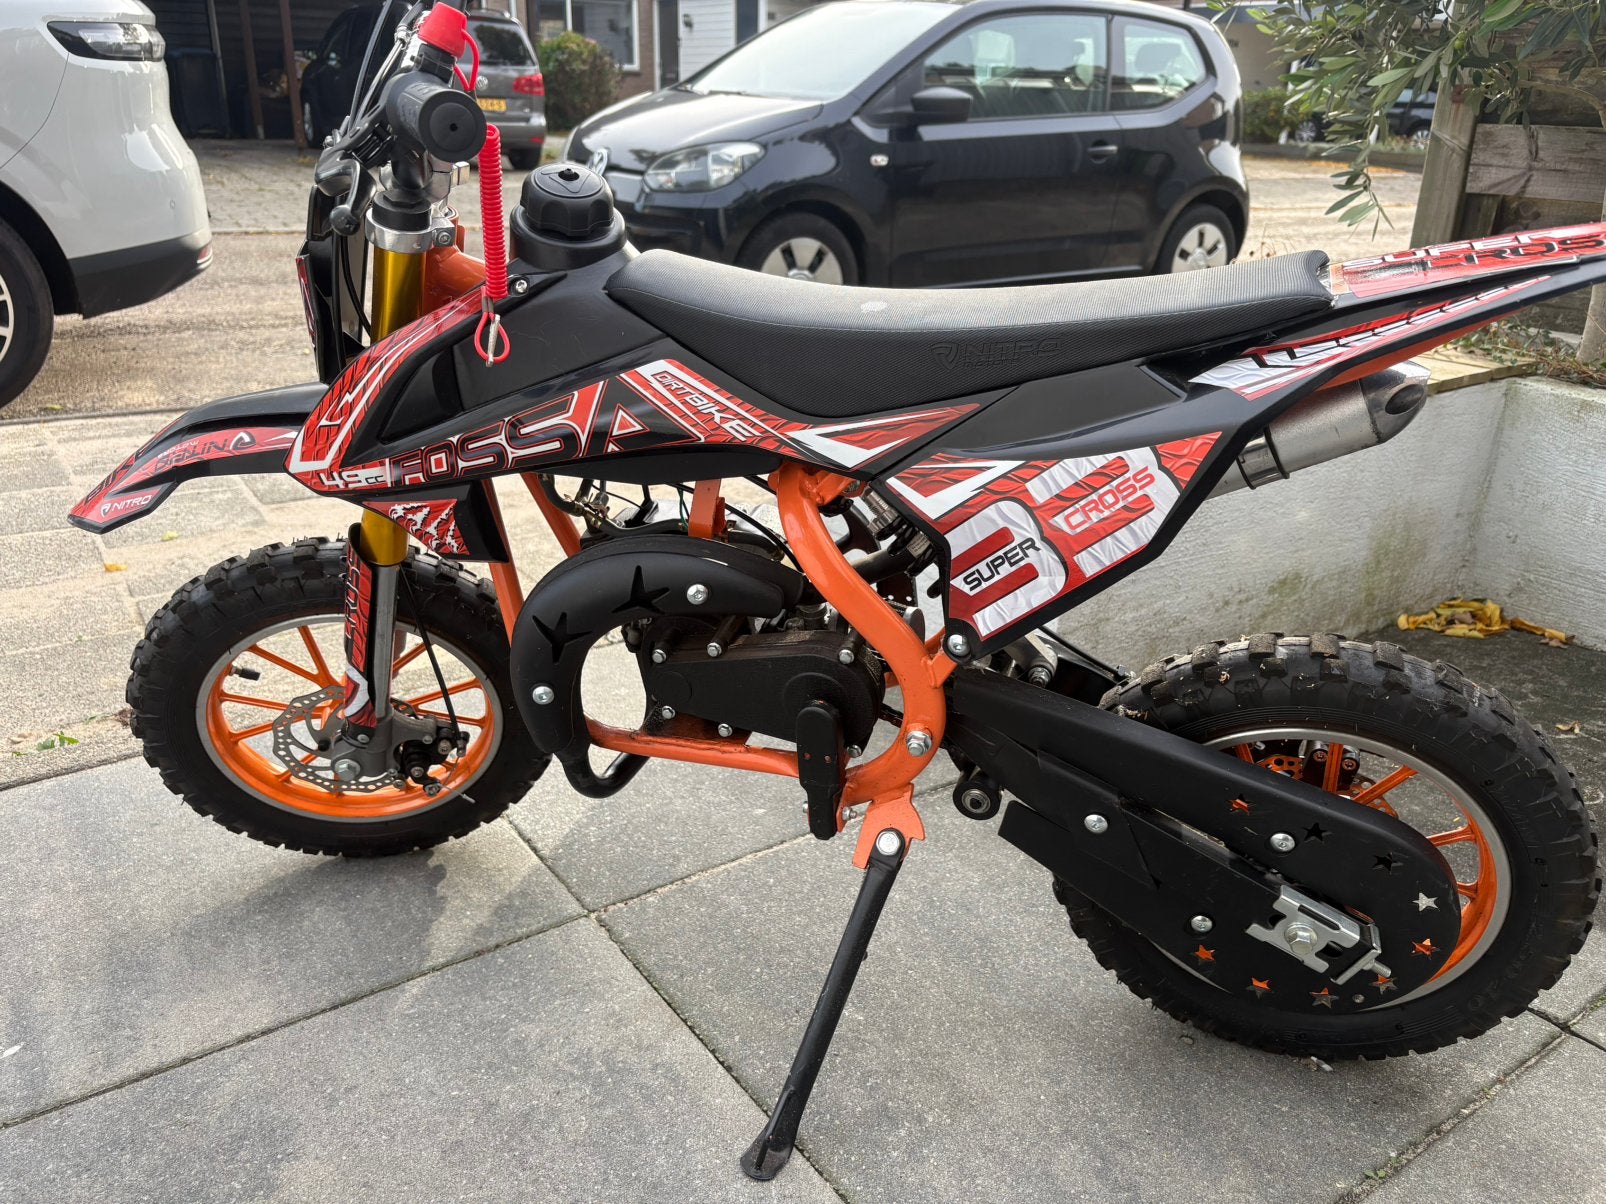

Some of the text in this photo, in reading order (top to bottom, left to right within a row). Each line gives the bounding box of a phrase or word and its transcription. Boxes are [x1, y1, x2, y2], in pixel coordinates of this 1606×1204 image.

[388, 376, 705, 487] FOSSA
[655, 374, 763, 442] DIRTBIKE
[112, 494, 153, 511] NITRO
[1063, 466, 1156, 530] CROSS
[962, 537, 1041, 592] SUPER
